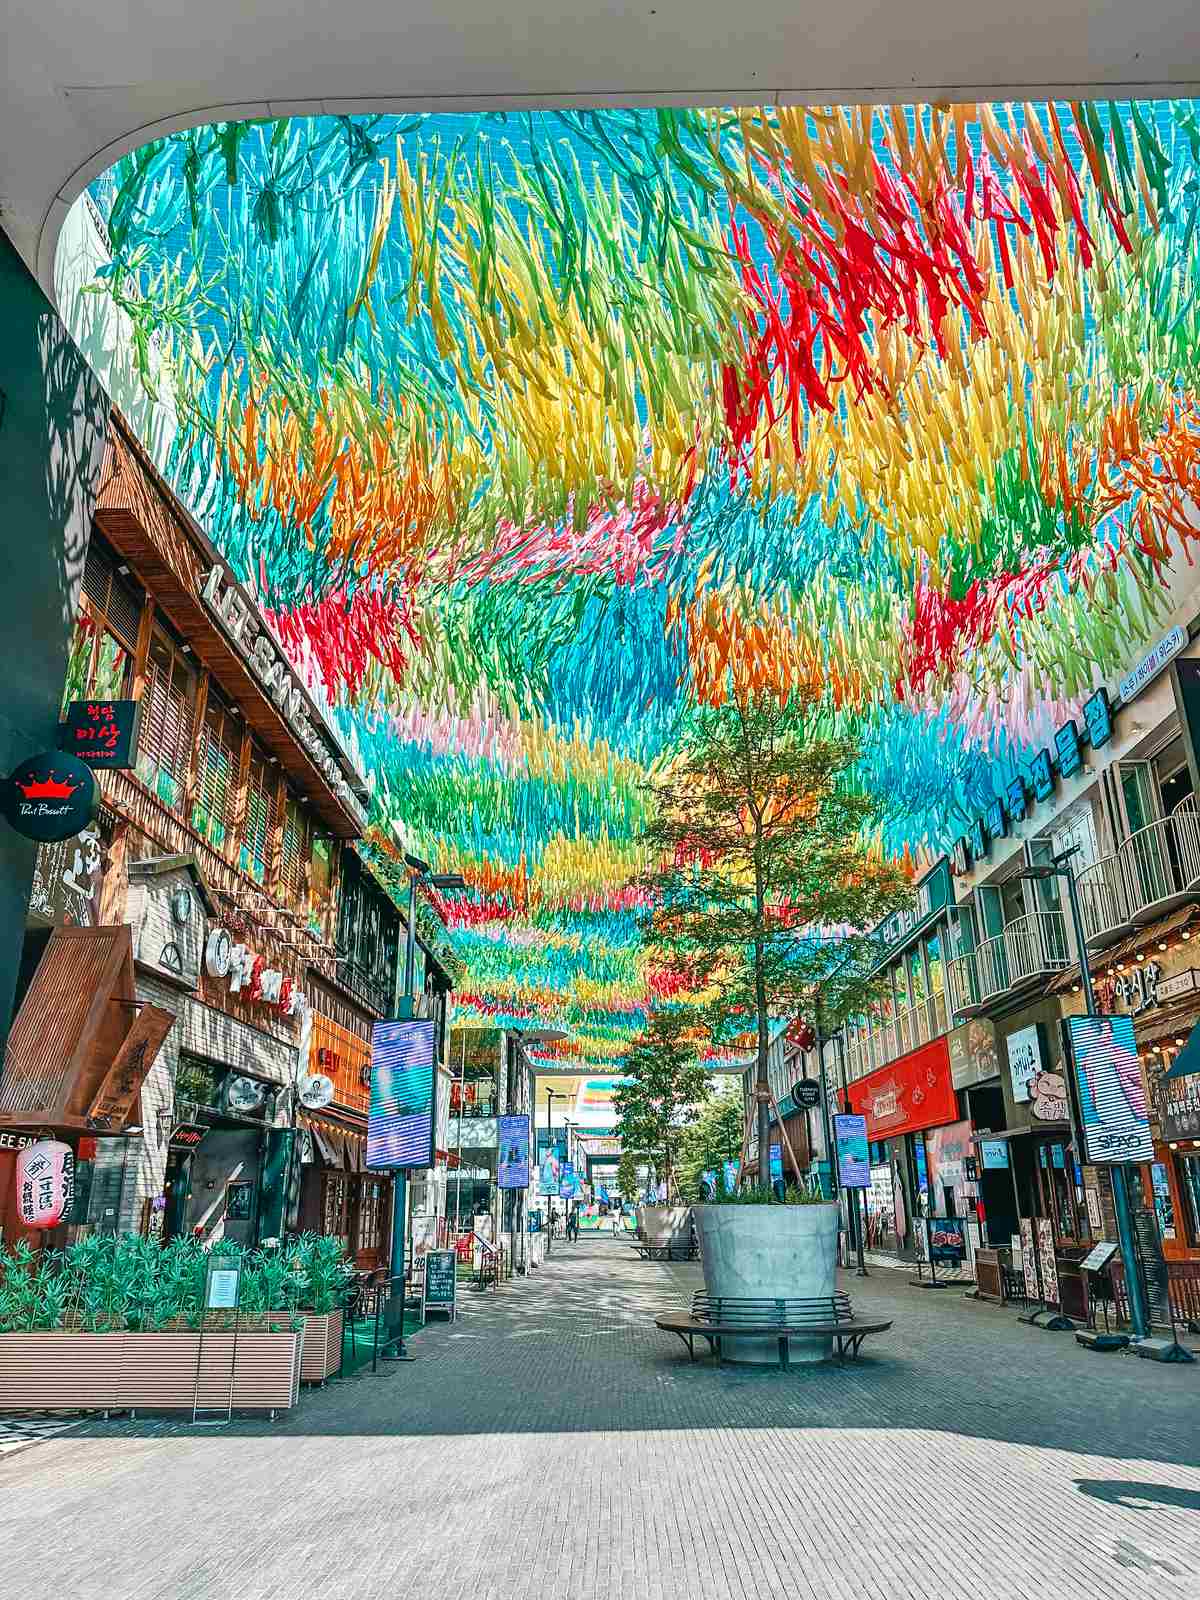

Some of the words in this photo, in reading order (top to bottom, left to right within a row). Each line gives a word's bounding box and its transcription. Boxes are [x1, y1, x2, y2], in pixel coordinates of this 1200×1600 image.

[1158, 631, 1181, 658] 위스키
[19, 802, 37, 816] Paul
[1098, 1134, 1141, 1150] SPAO
